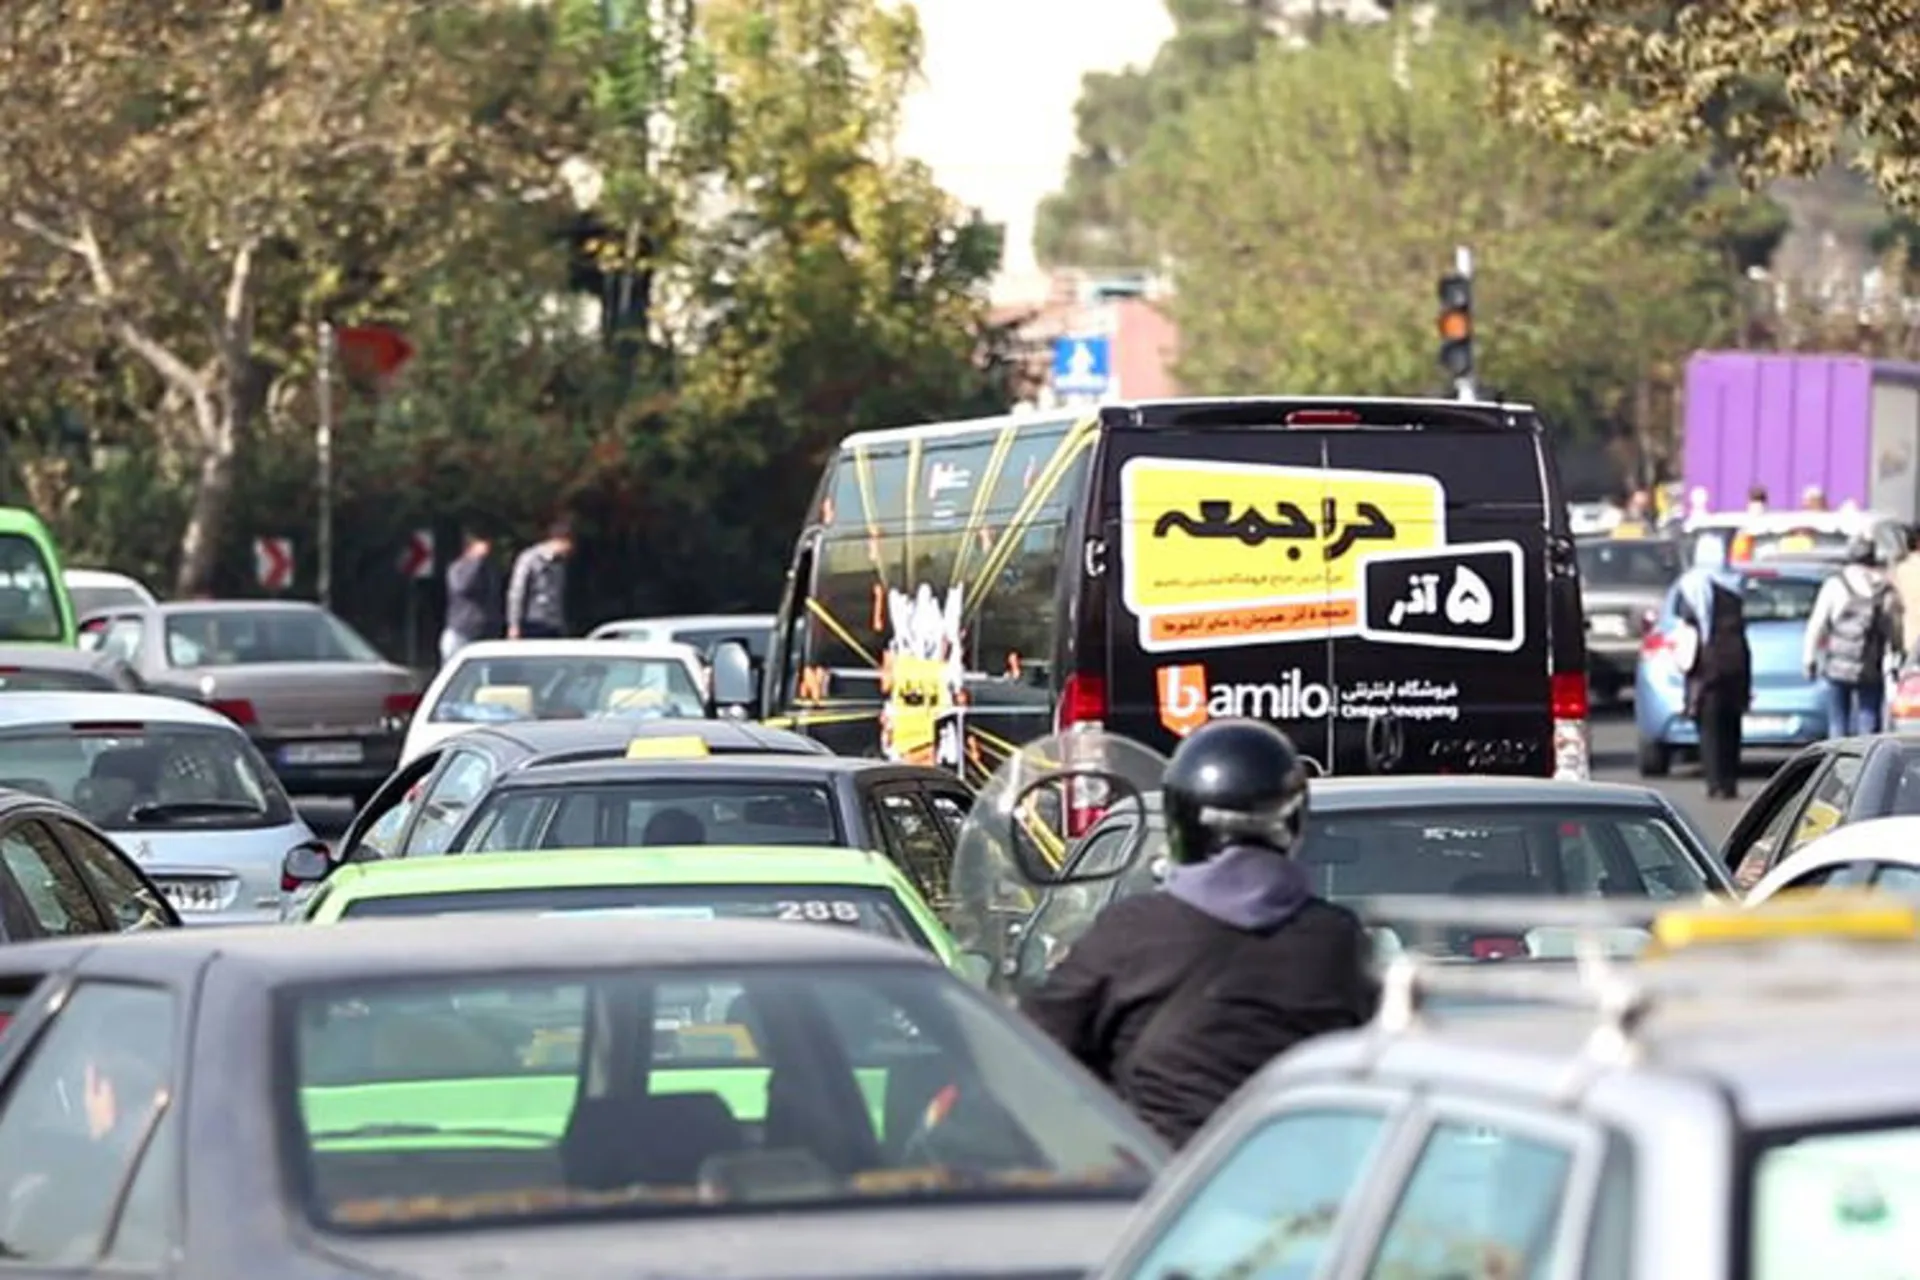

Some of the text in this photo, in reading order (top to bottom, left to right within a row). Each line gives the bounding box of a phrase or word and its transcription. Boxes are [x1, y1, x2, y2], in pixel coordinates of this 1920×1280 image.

[1388, 563, 1493, 626] ۵ آذر
[1167, 664, 1330, 719] bamilo
[1341, 679, 1459, 702] فروشگاه اینترنتی
